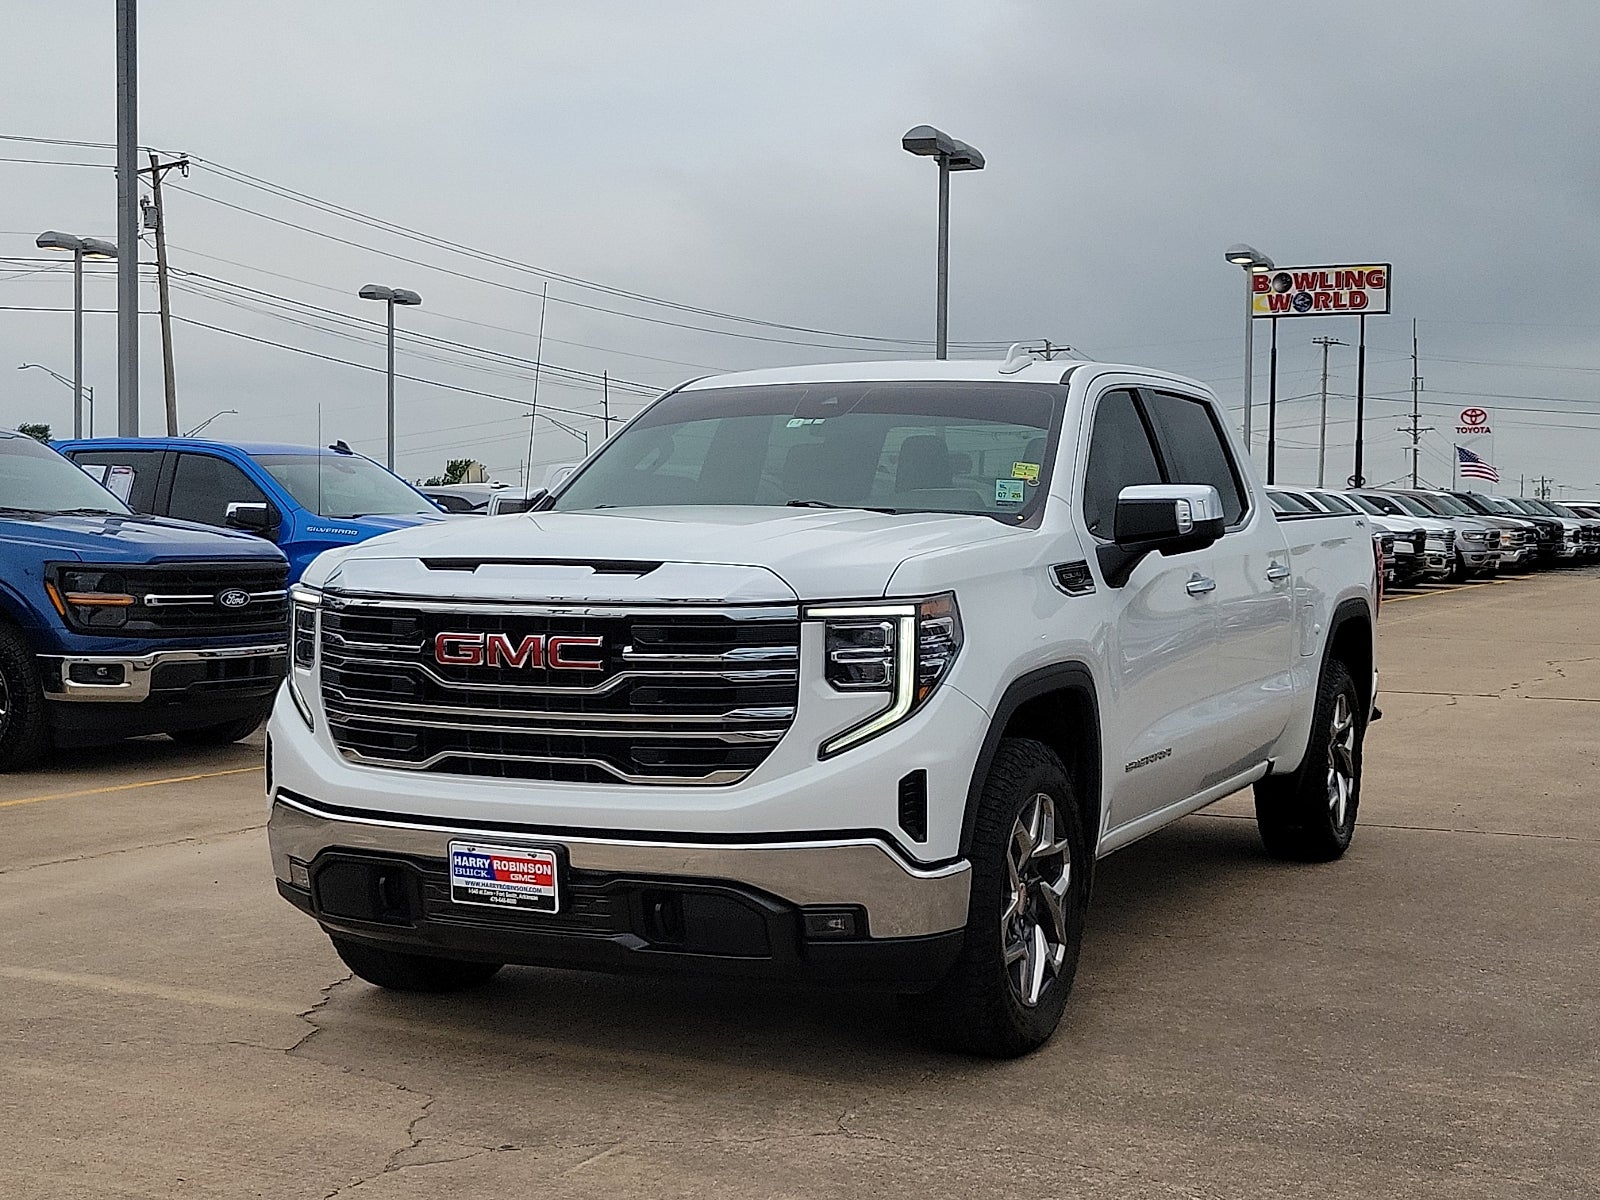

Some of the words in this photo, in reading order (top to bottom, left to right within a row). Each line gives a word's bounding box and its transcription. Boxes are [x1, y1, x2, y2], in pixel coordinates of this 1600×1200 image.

[1252, 269, 1386, 293] BOWLING
[1267, 290, 1369, 313] WORLD
[1455, 426, 1491, 434] TOYOTA
[226, 592, 246, 605] Ford
[435, 632, 604, 671] GMC
[453, 855, 491, 869] HARRY
[493, 860, 552, 875] ROBINSON
[454, 867, 489, 878] BUICK
[510, 873, 537, 883] GMC
